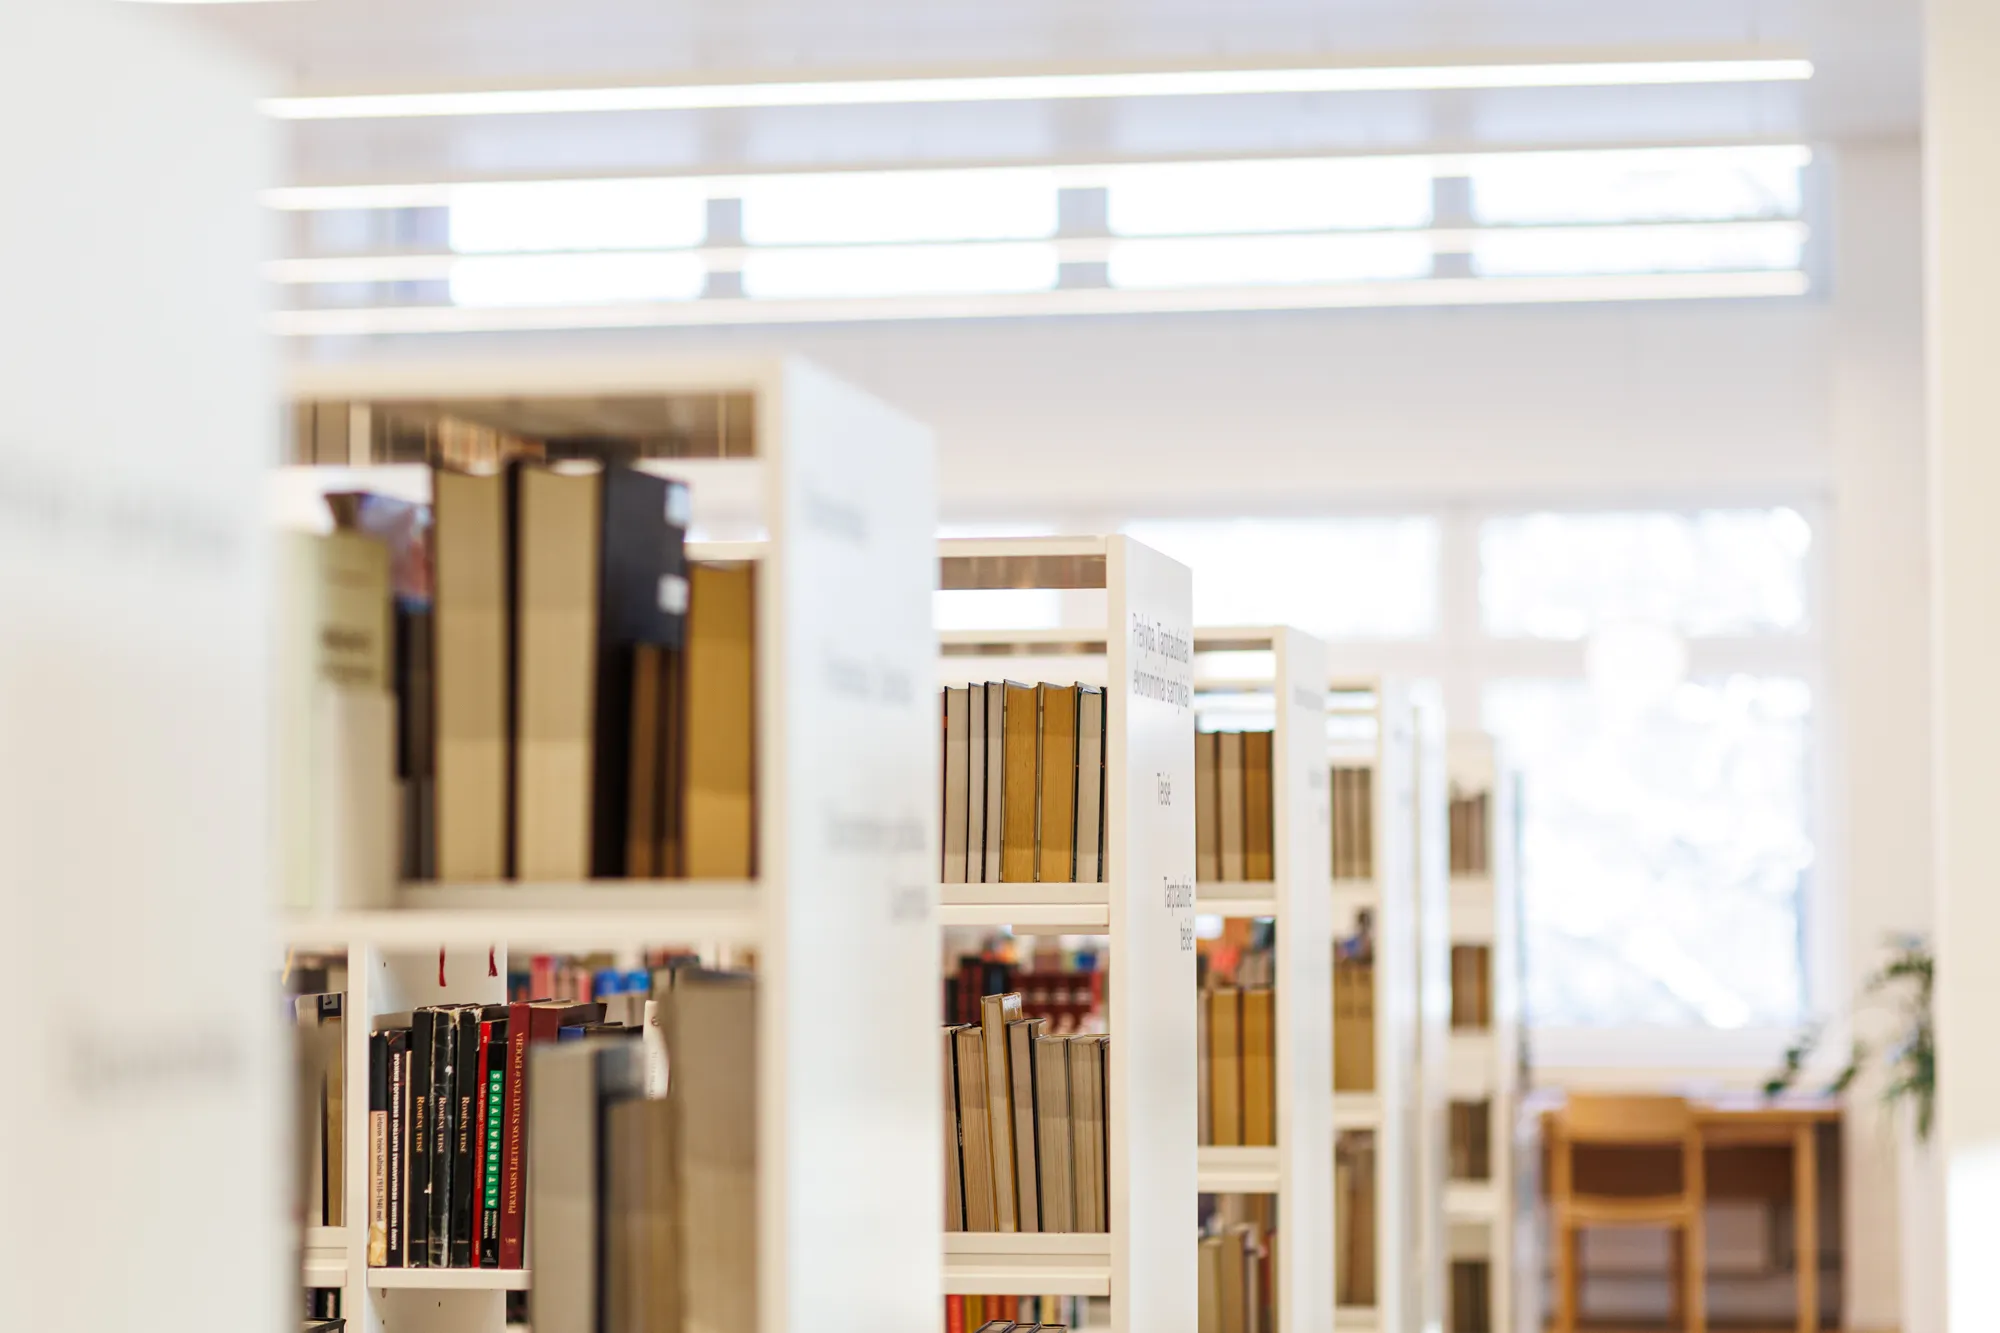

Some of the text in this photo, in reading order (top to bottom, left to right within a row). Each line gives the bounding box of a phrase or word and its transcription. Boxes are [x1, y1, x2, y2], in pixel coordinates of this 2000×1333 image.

[1133, 612, 1188, 666] Prekyba. Tarptautiniai
[1133, 659, 1189, 715] ekonominiai santykiai
[1156, 771, 1171, 806] Teisė
[1163, 875, 1192, 916] Tarptautinė
[1180, 917, 1192, 951] teisė
[515, 1032, 524, 1069] EPOCHA
[392, 1082, 400, 1118] ENERGIJOS
[511, 1079, 521, 1124] STATUTAS
[488, 1073, 501, 1206] ALTERNATYVOS
[509, 1125, 520, 1171] LIETUVOS
[391, 1152, 399, 1201] REGULIAVIMAS
[508, 1172, 518, 1213] PIRMASIS
